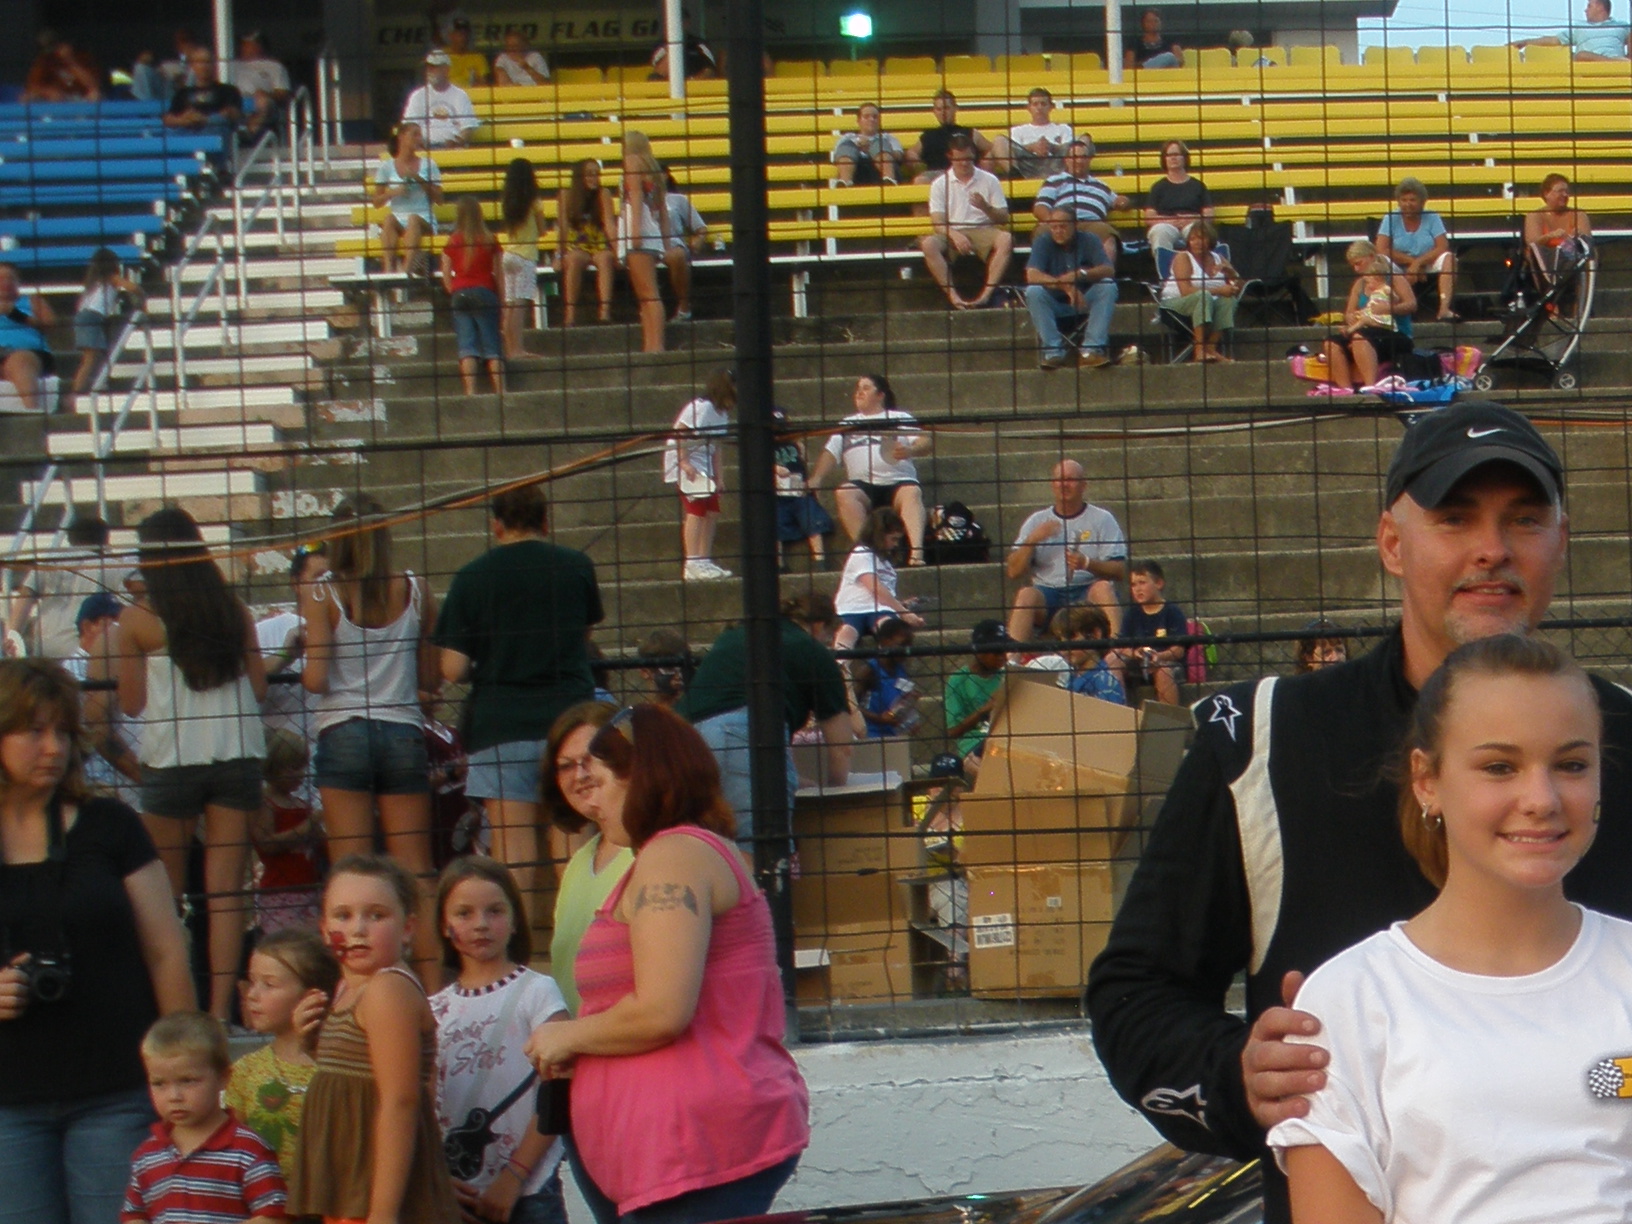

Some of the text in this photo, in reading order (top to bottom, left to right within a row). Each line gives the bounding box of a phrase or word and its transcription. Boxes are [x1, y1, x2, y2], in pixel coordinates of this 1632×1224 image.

[378, 17, 661, 46] CHEERED FLAG GI
